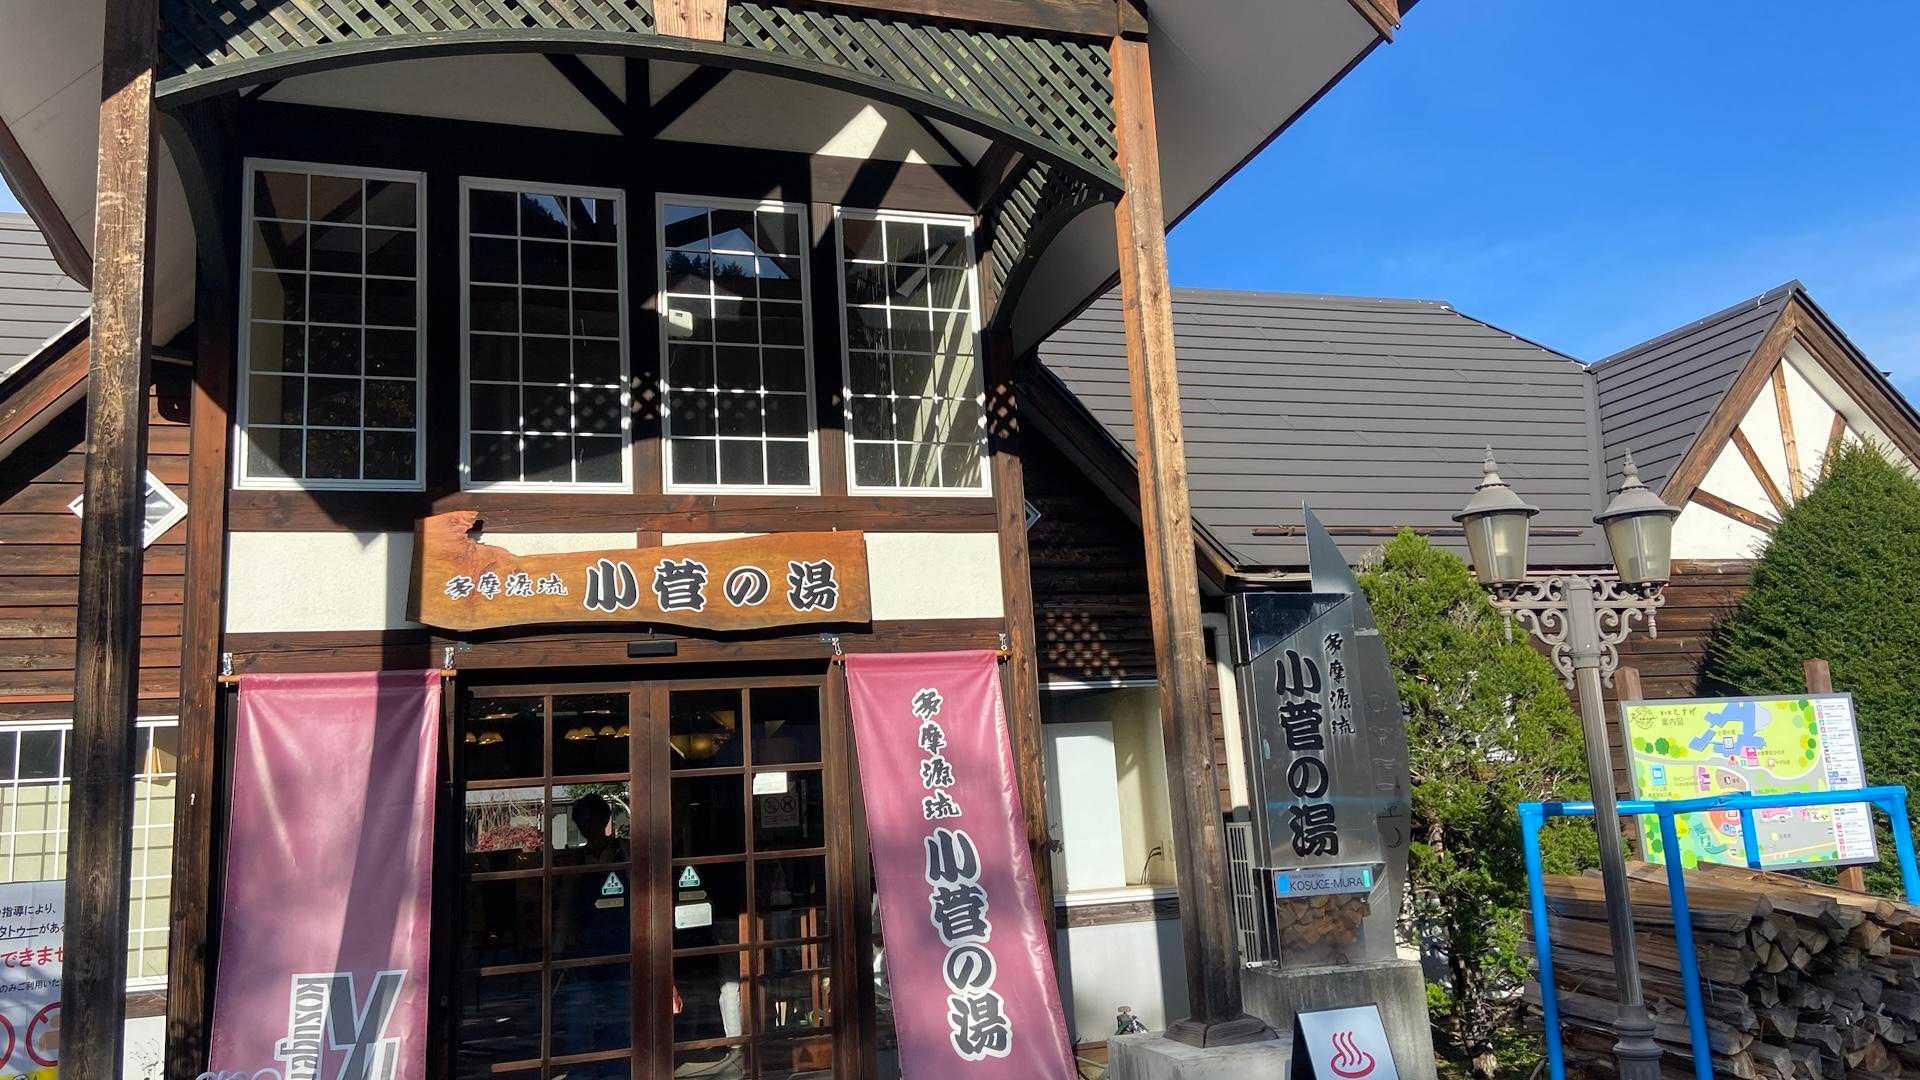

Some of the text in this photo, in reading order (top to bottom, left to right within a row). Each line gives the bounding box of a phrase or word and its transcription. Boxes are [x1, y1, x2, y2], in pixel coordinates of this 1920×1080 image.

[445, 557, 838, 613] 多摩源流 小菅の湯
[1274, 649, 1339, 858] 小菅の湯
[1323, 631, 1356, 738] 多摩源流
[912, 688, 1012, 1062] 多摩源流 小菅の湯
